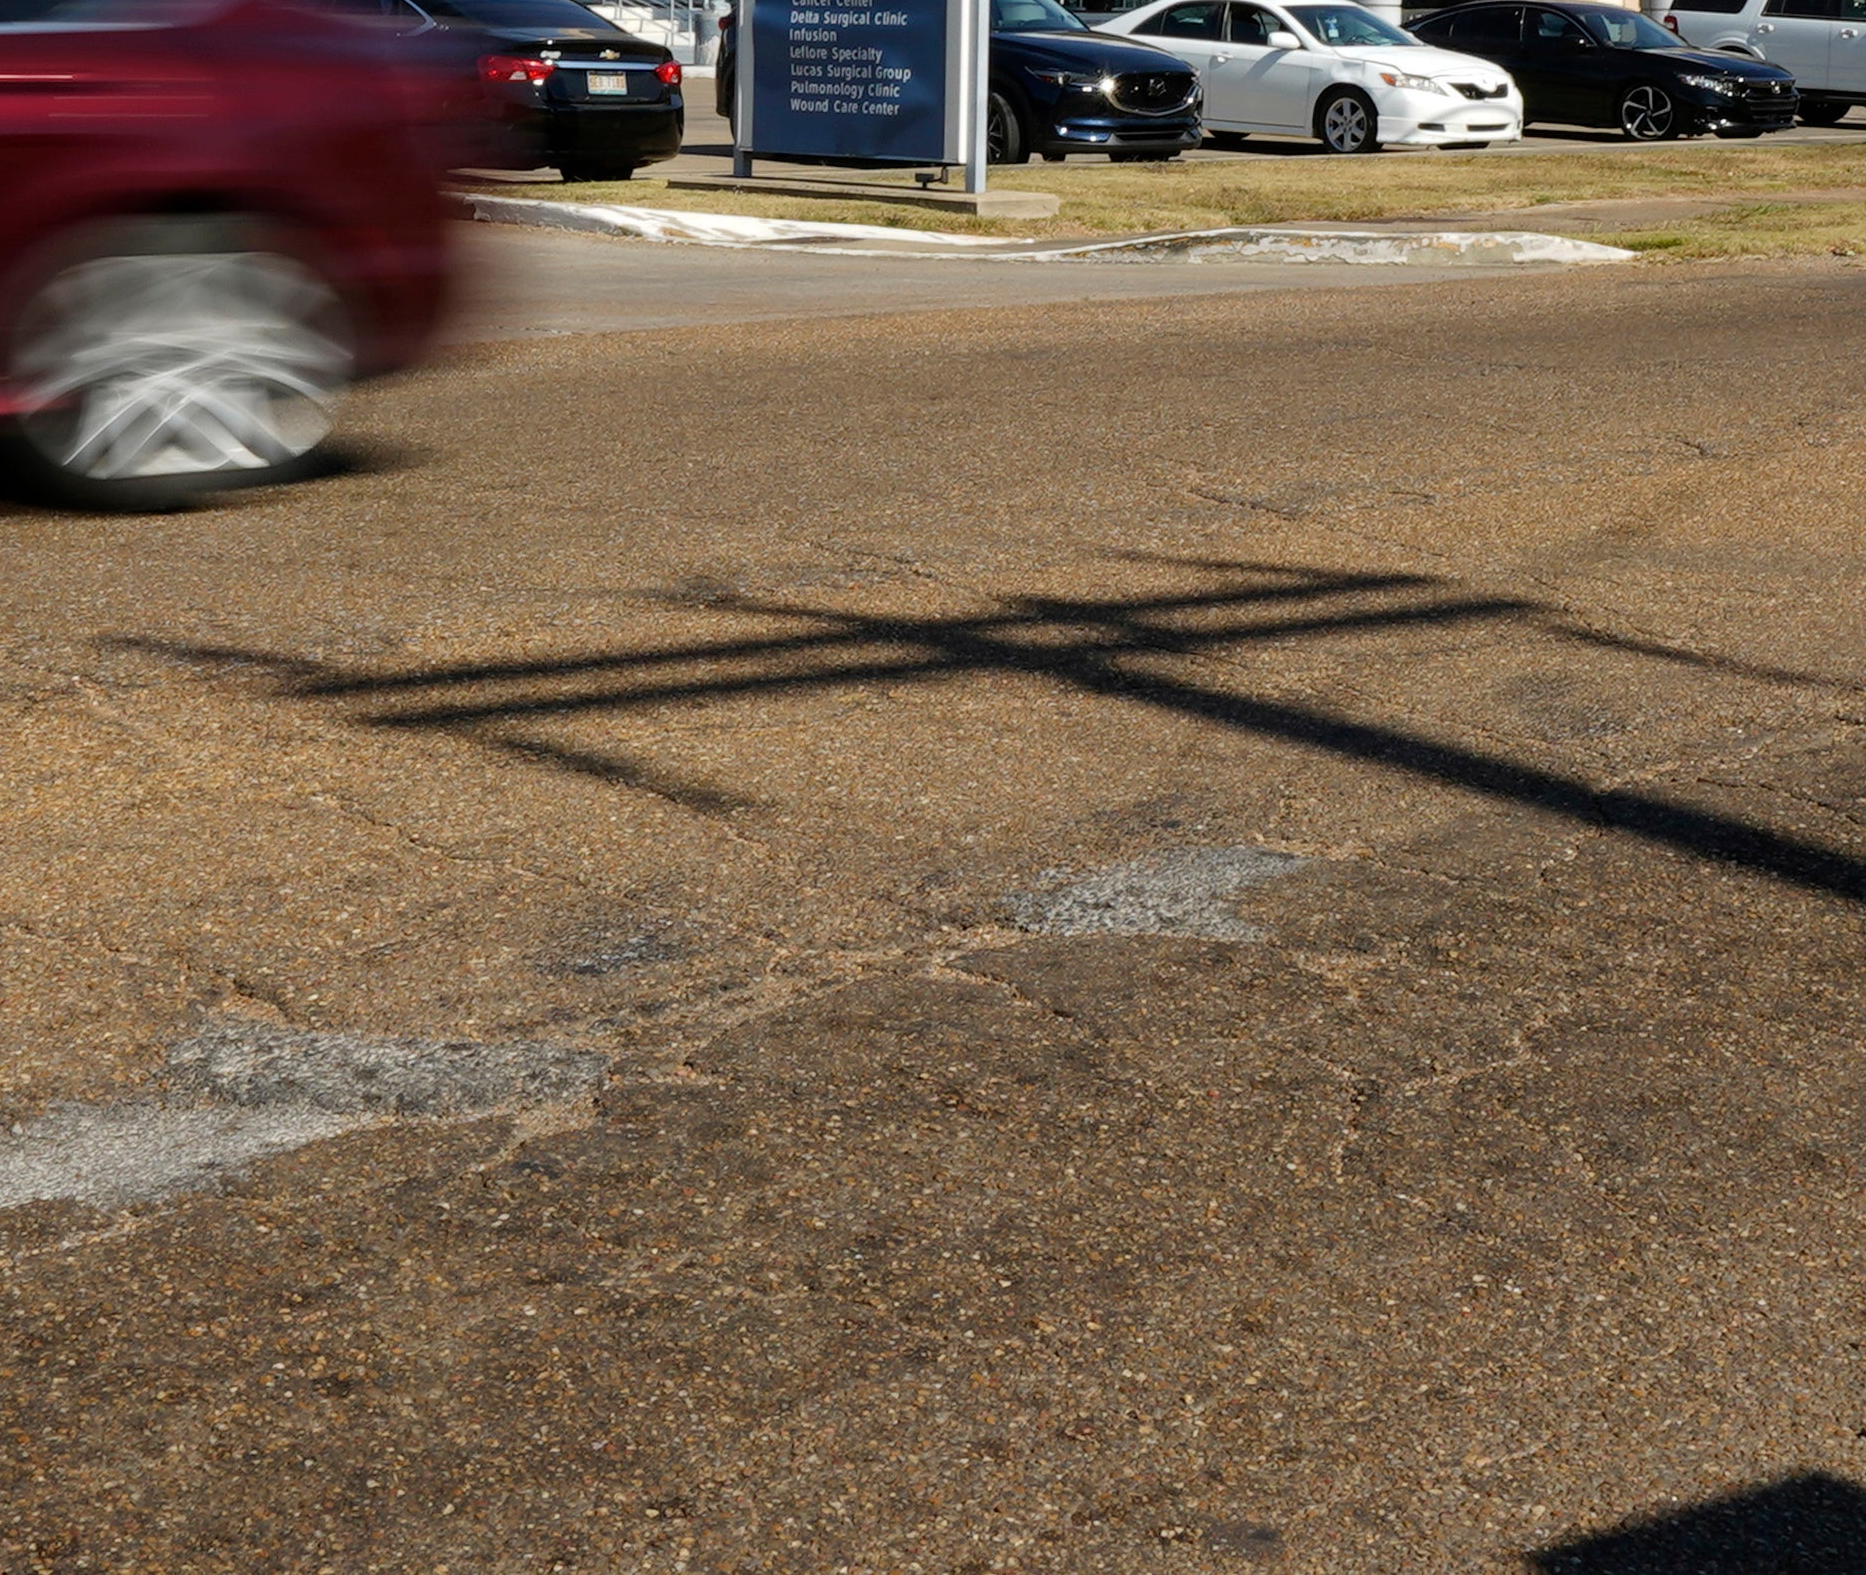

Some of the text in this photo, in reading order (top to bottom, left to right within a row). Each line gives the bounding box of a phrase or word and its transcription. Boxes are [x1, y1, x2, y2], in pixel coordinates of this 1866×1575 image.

[790, 11, 908, 27] Delta Surgical Clinic
[790, 29, 837, 41] Infusion
[790, 46, 882, 64] Leflore Specialty
[791, 64, 911, 82] Lucas Surgical Group
[791, 81, 899, 98] Pulmonology Clinic
[790, 99, 899, 114] Wound Care Center
